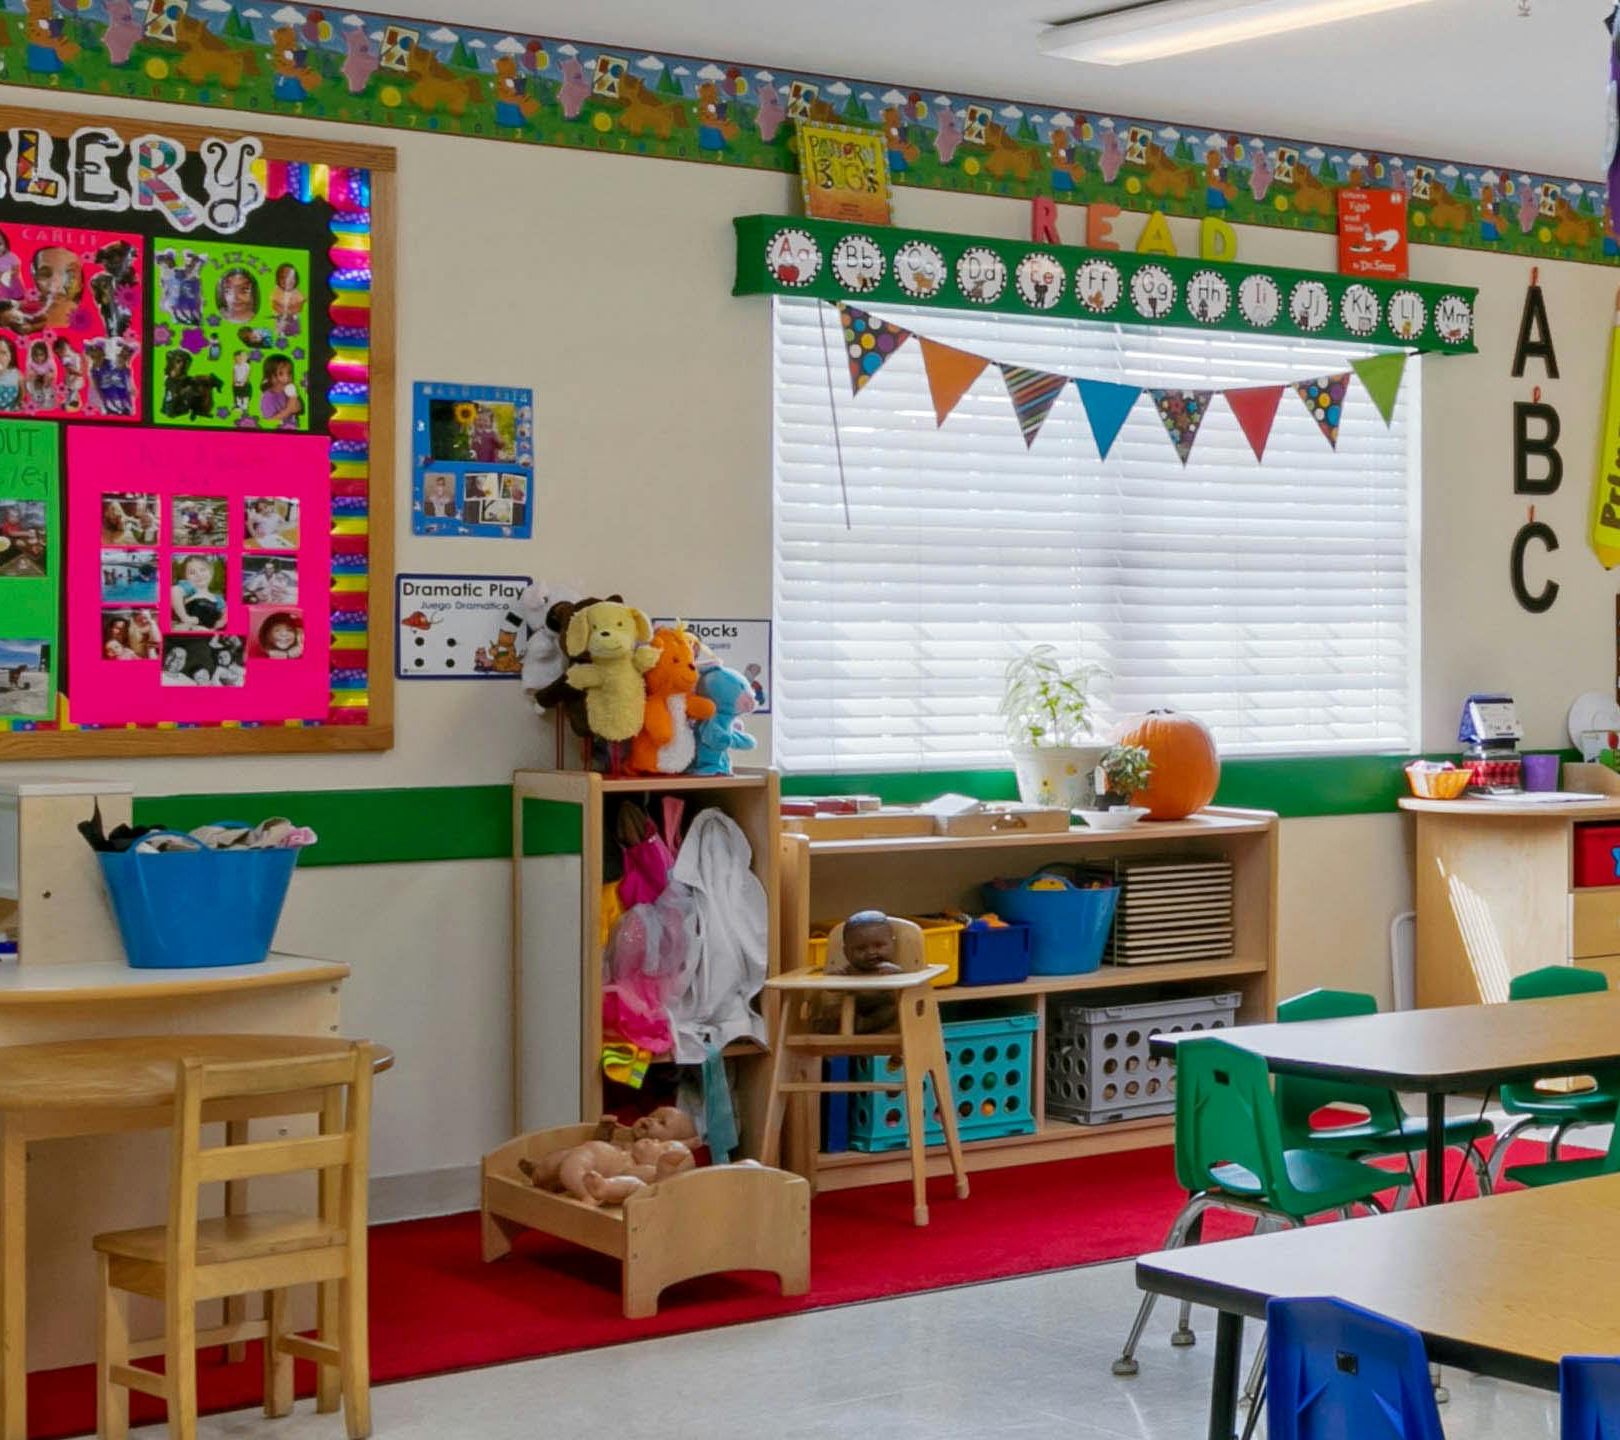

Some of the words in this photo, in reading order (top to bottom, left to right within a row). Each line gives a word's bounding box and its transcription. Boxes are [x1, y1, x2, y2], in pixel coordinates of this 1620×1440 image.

[1032, 197, 1237, 263] READ
[777, 237, 810, 261] Aa
[846, 245, 874, 269] Bb
[968, 256, 996, 281] Dd
[1088, 271, 1109, 291] Ff
[1141, 272, 1169, 301] Gg
[1301, 289, 1320, 317] Jj
[1351, 292, 1373, 314] Kk
[1442, 305, 1469, 324] Mm
[1511, 285, 1560, 379] A
[1513, 401, 1564, 496] B
[403, 582, 483, 597] Dramatic
[490, 583, 525, 600] Play
[421, 601, 452, 611] Juego
[1510, 521, 1560, 614] C
